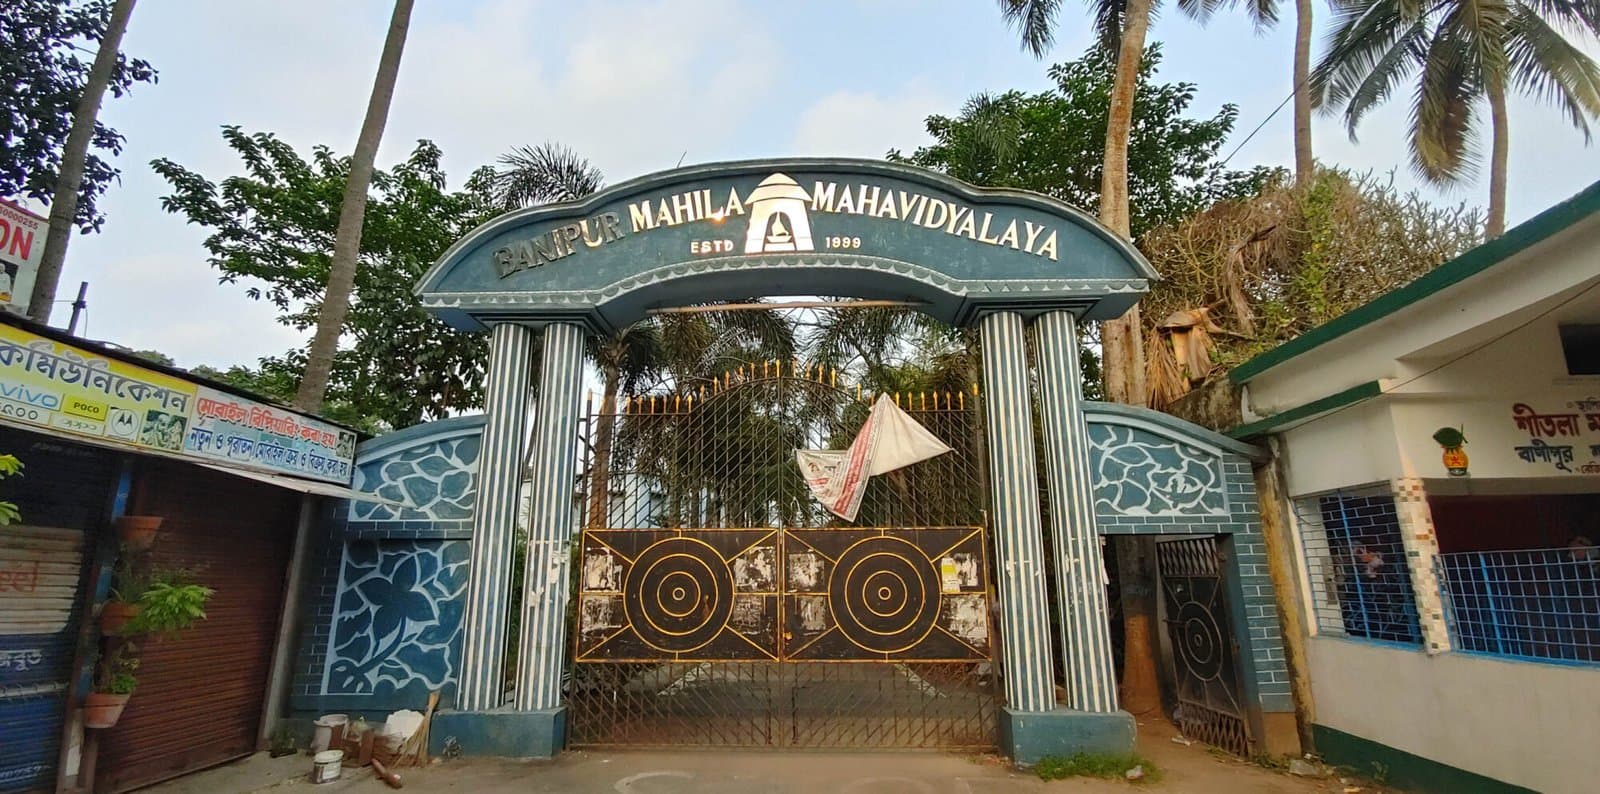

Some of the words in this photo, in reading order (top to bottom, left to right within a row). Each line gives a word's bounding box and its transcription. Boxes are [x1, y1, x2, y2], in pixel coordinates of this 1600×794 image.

[492, 211, 626, 280] BANIPUR
[629, 187, 745, 233] MAHILA
[811, 181, 1059, 262] MAHAVIDYALAYA
[690, 239, 735, 254] ESTD
[825, 236, 862, 249] 1999
[0, 382, 59, 408] vivo
[73, 402, 100, 414] POCO
[1512, 403, 1580, 437] শীতলা
[190, 427, 213, 451] নতুন
[216, 432, 224, 449] ও
